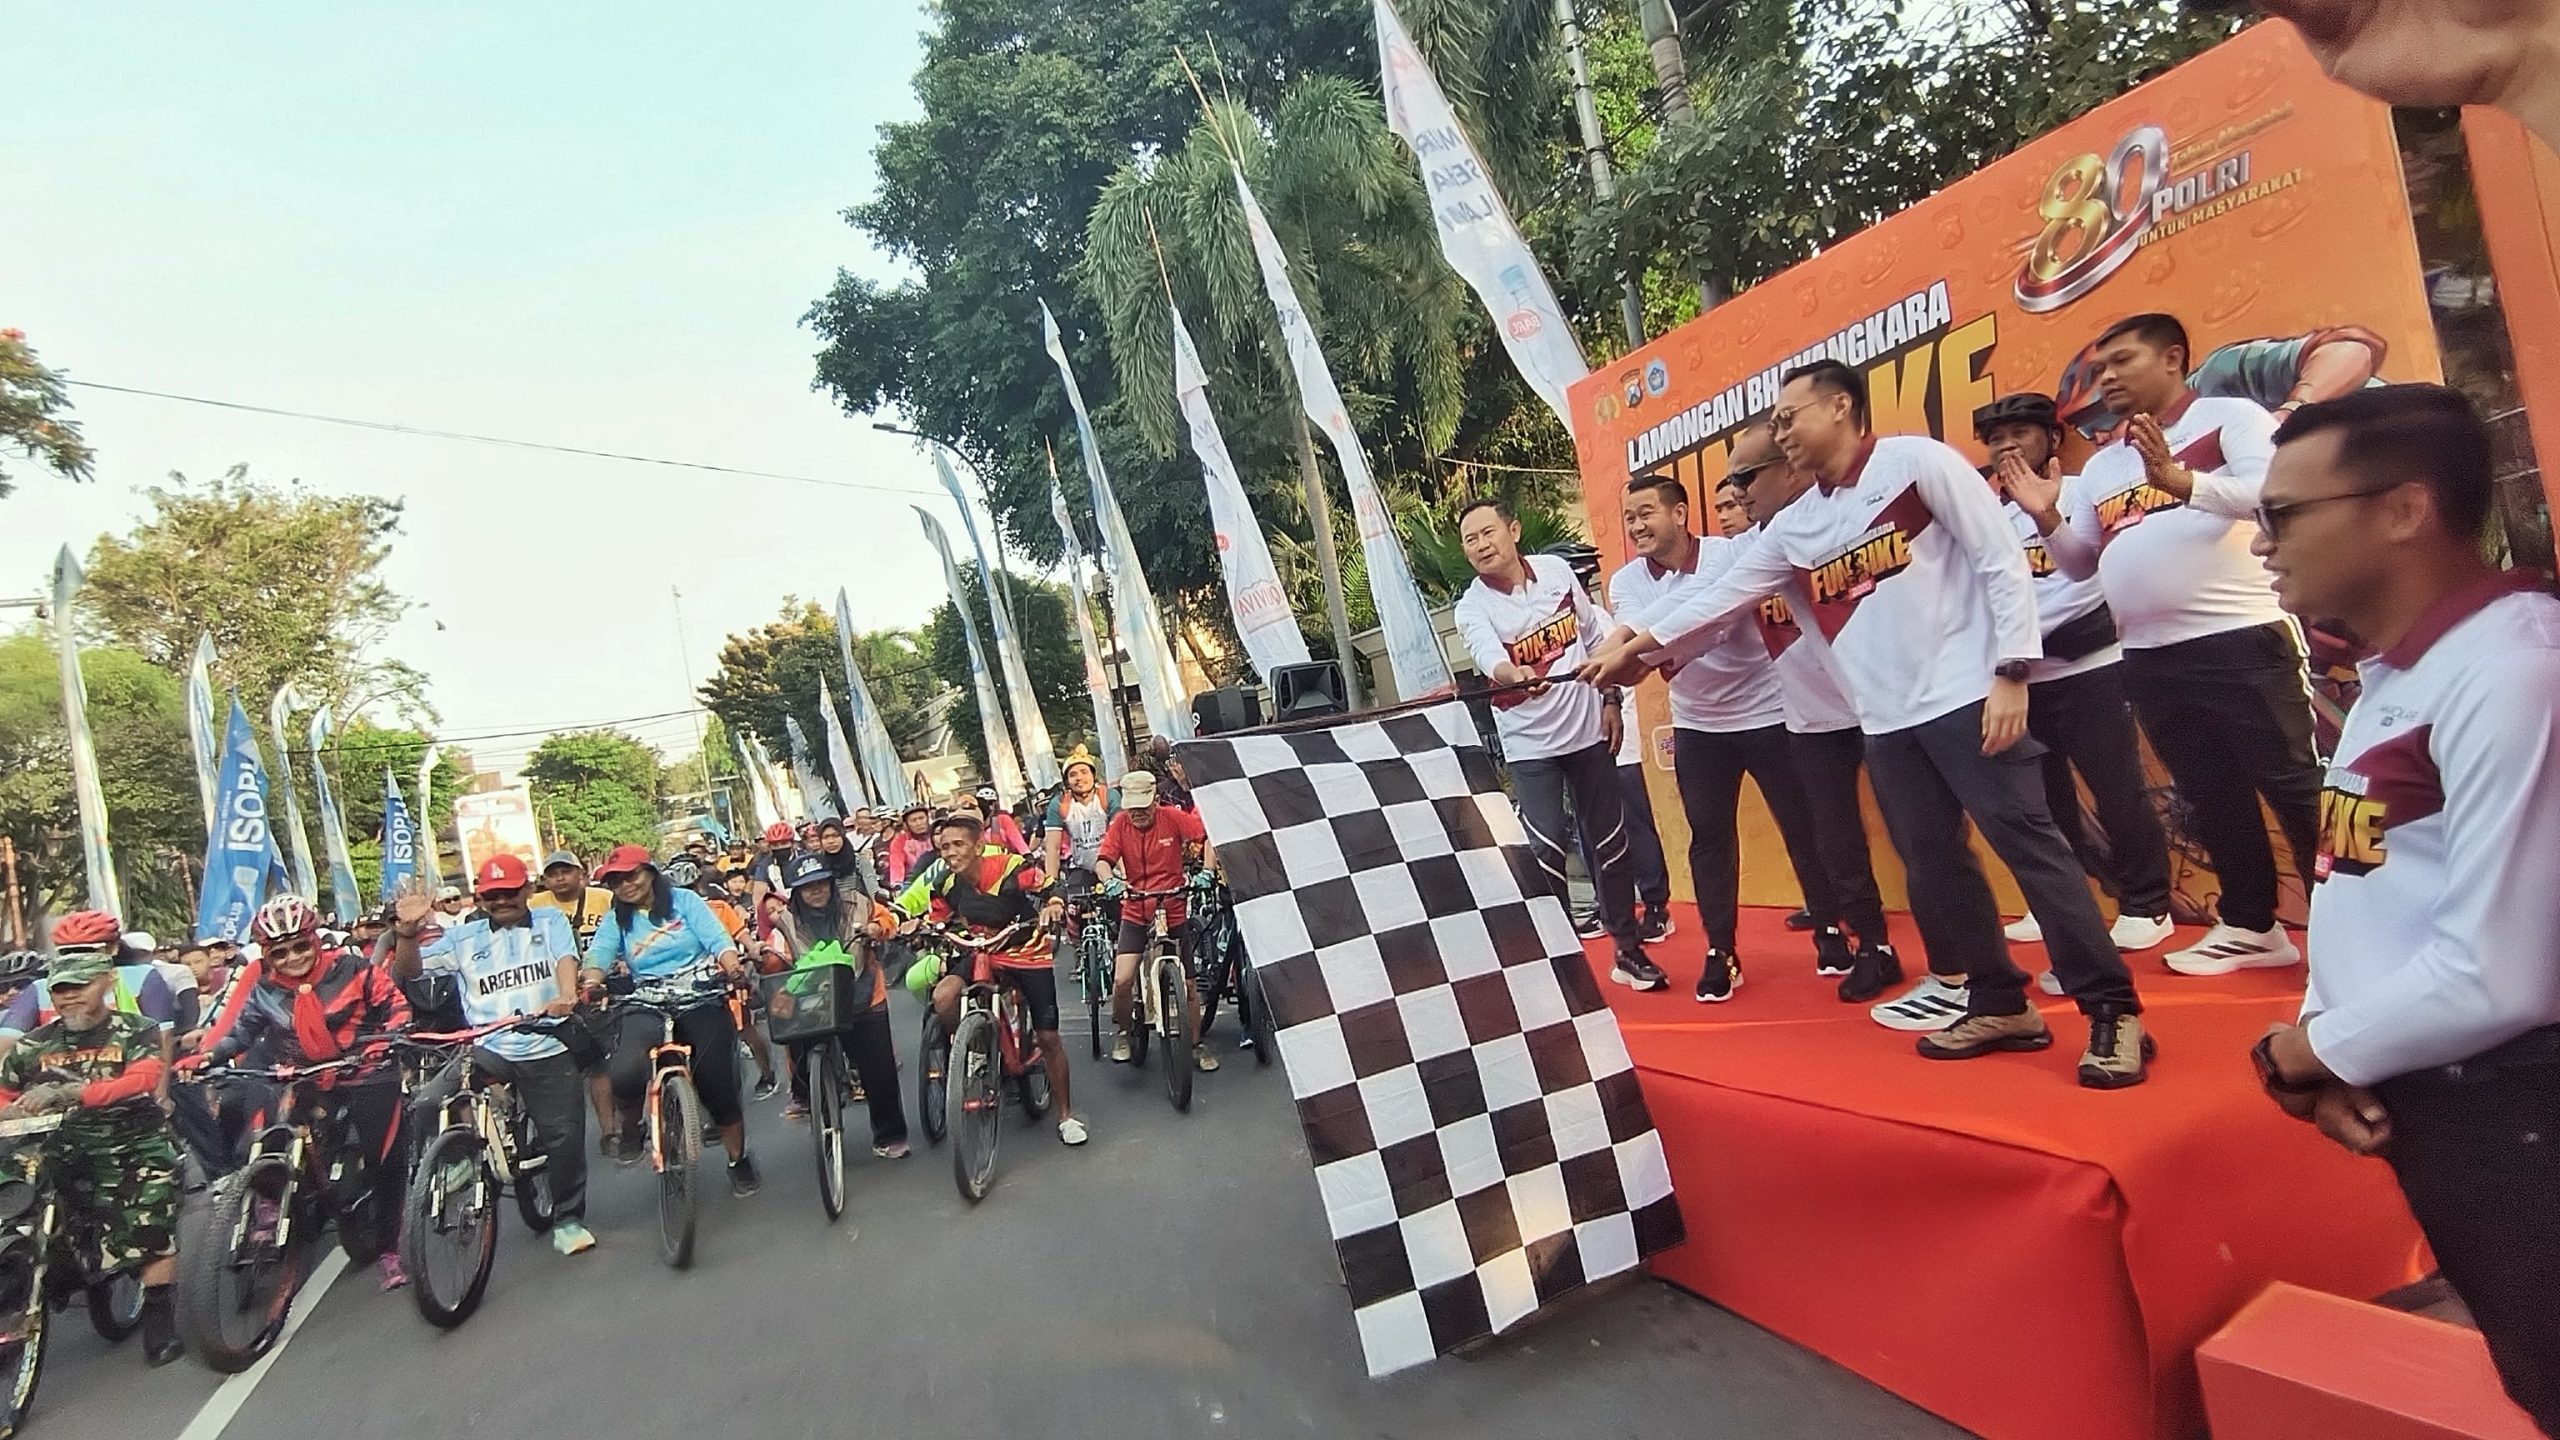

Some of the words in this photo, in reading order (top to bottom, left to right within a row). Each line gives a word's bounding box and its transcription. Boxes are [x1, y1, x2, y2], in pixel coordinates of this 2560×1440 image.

[2030, 123, 2170, 285] 80
[2138, 216, 2189, 248] UNTUK
[2191, 167, 2303, 226] MASYARAKAT
[2151, 151, 2251, 223] POLRI
[1627, 383, 1745, 473] LAMONGAN
[1810, 553, 1852, 602] FUN
[1512, 629, 1546, 668] FUN
[479, 959, 552, 996] ARGENTINA
